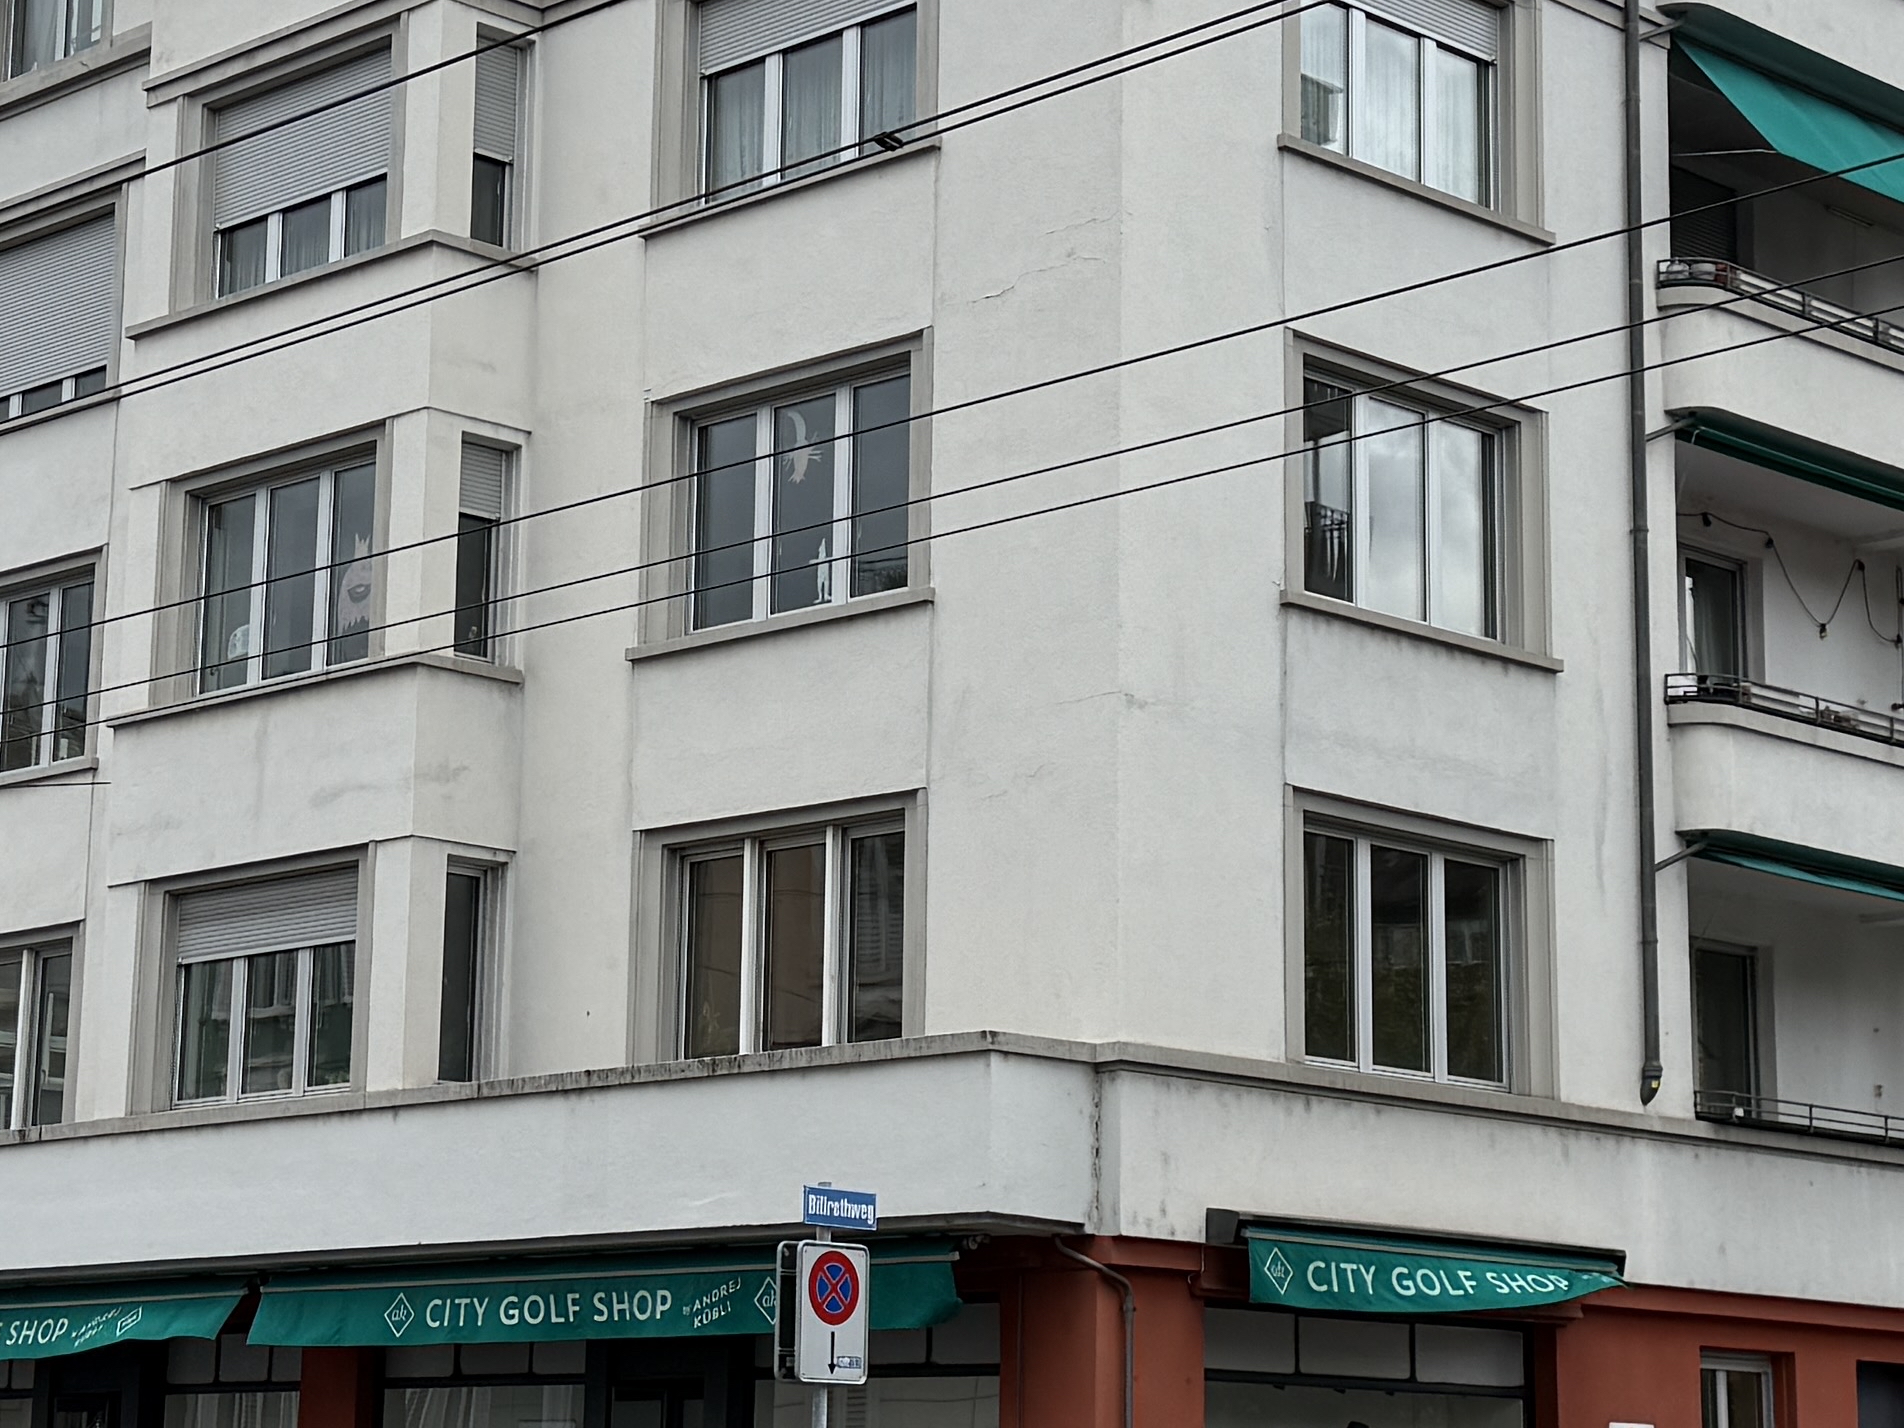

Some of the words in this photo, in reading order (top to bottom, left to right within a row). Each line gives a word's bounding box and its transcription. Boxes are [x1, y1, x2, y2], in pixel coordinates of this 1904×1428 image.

[808, 1194, 874, 1224] Billrothweg
[693, 1276, 741, 1313] ANDREJ
[1307, 1261, 1377, 1295] CITY
[1391, 1265, 1477, 1296] GOLF
[1486, 1272, 1570, 1295] SHOP
[426, 1296, 489, 1328] CITY
[498, 1293, 580, 1326] GOLF
[593, 1289, 672, 1322] SHOP
[5, 1317, 69, 1346] SHOP
